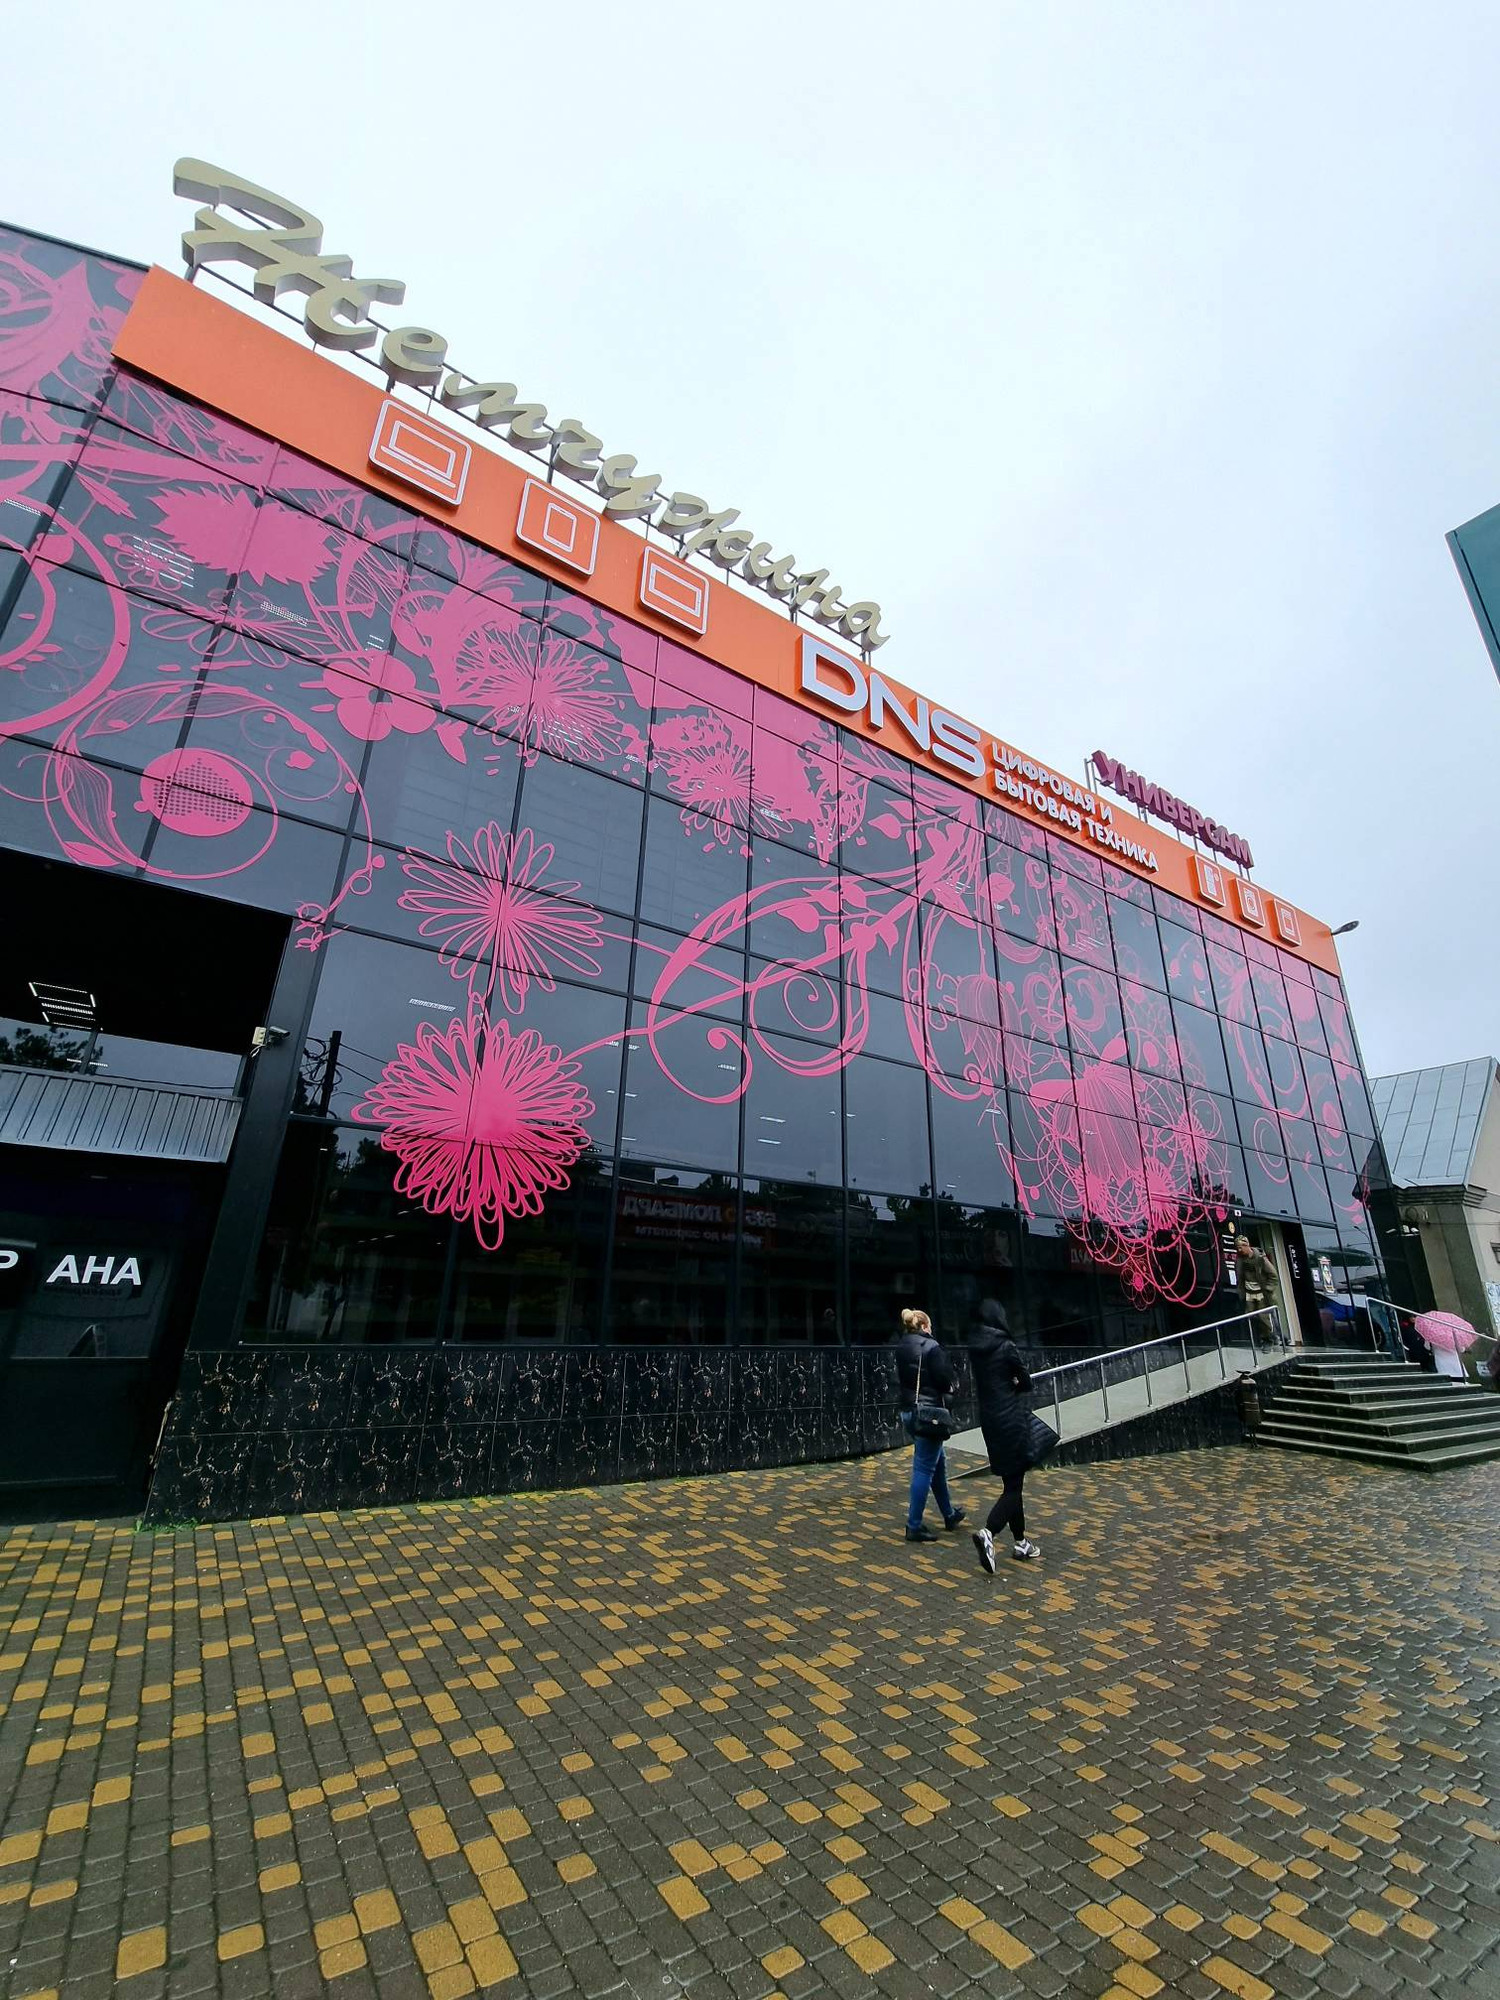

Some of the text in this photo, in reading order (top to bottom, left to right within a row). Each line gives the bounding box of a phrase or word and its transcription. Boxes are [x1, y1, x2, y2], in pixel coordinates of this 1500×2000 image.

[173, 157, 891, 653] Жемчужина
[801, 633, 986, 779] DNS
[991, 741, 1114, 824] ЦИФРОВАЯ И
[994, 768, 1159, 873] БЫТОВАЯ ТЕХНИКА
[1091, 750, 1254, 869] УНИВЕРСАМ
